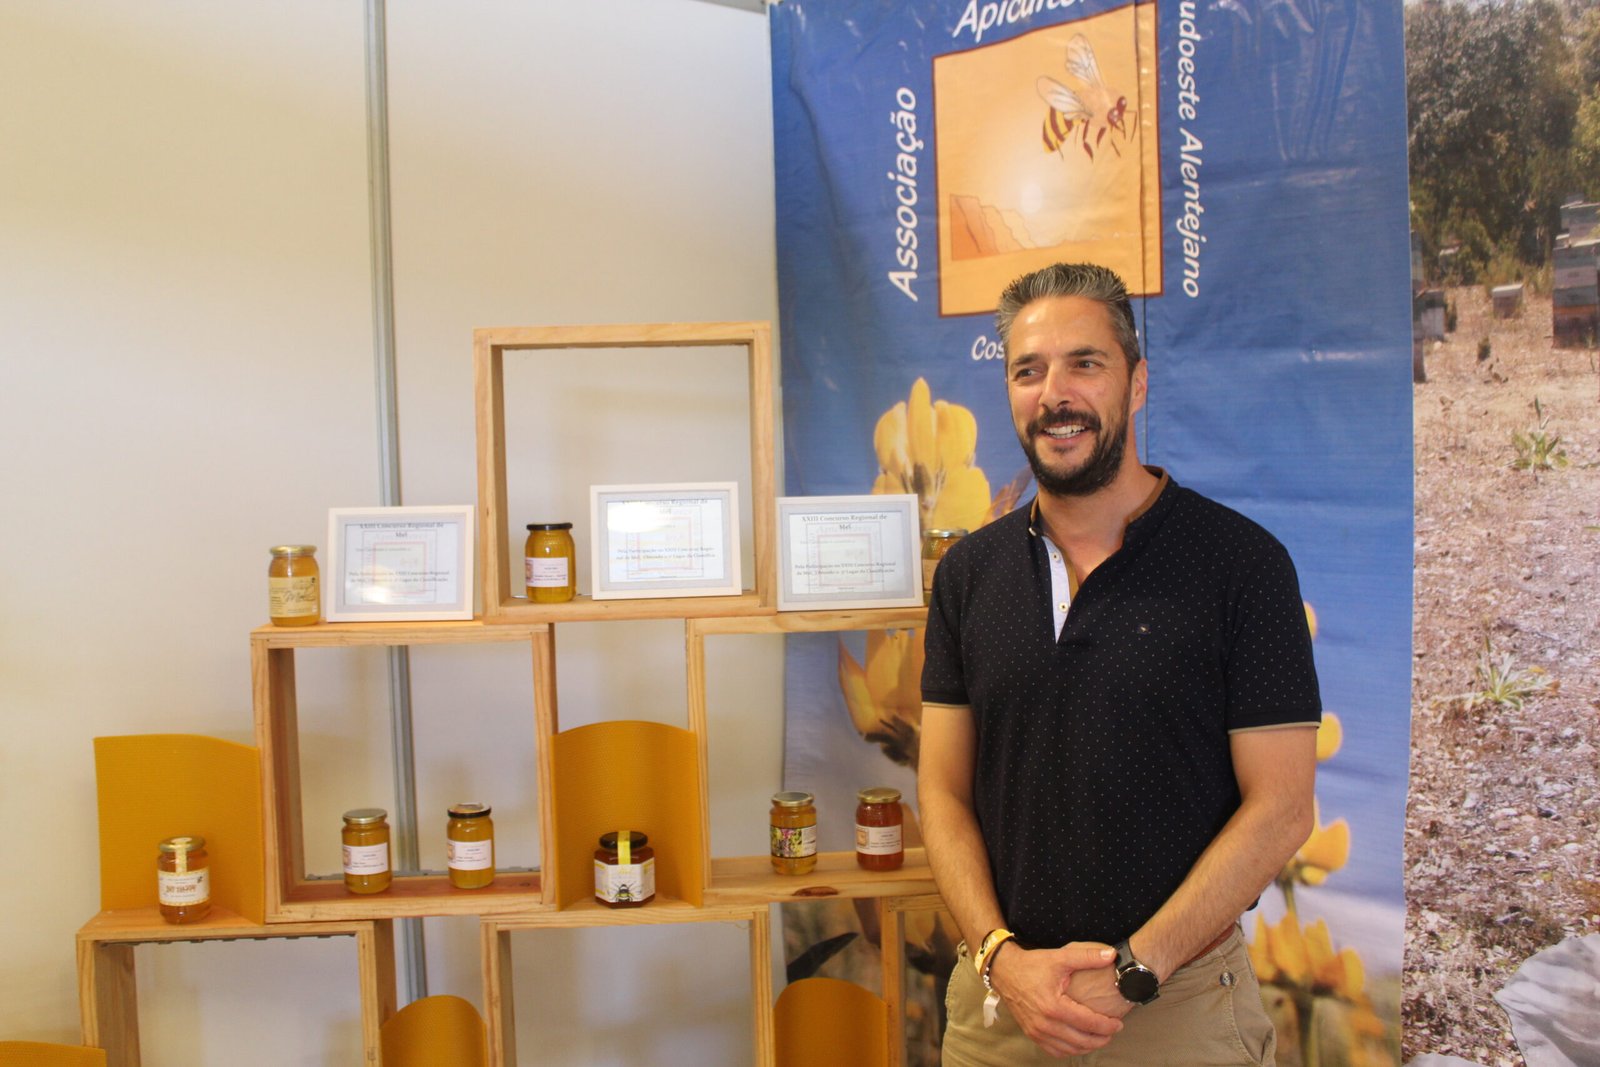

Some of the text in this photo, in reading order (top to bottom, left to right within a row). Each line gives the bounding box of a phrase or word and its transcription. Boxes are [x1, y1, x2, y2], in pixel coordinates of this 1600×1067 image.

[952, 0, 1085, 43] Apicu
[887, 87, 924, 302] Associação
[1176, 1, 1207, 299] udoeste Alentejano
[972, 335, 1006, 361] Cos
